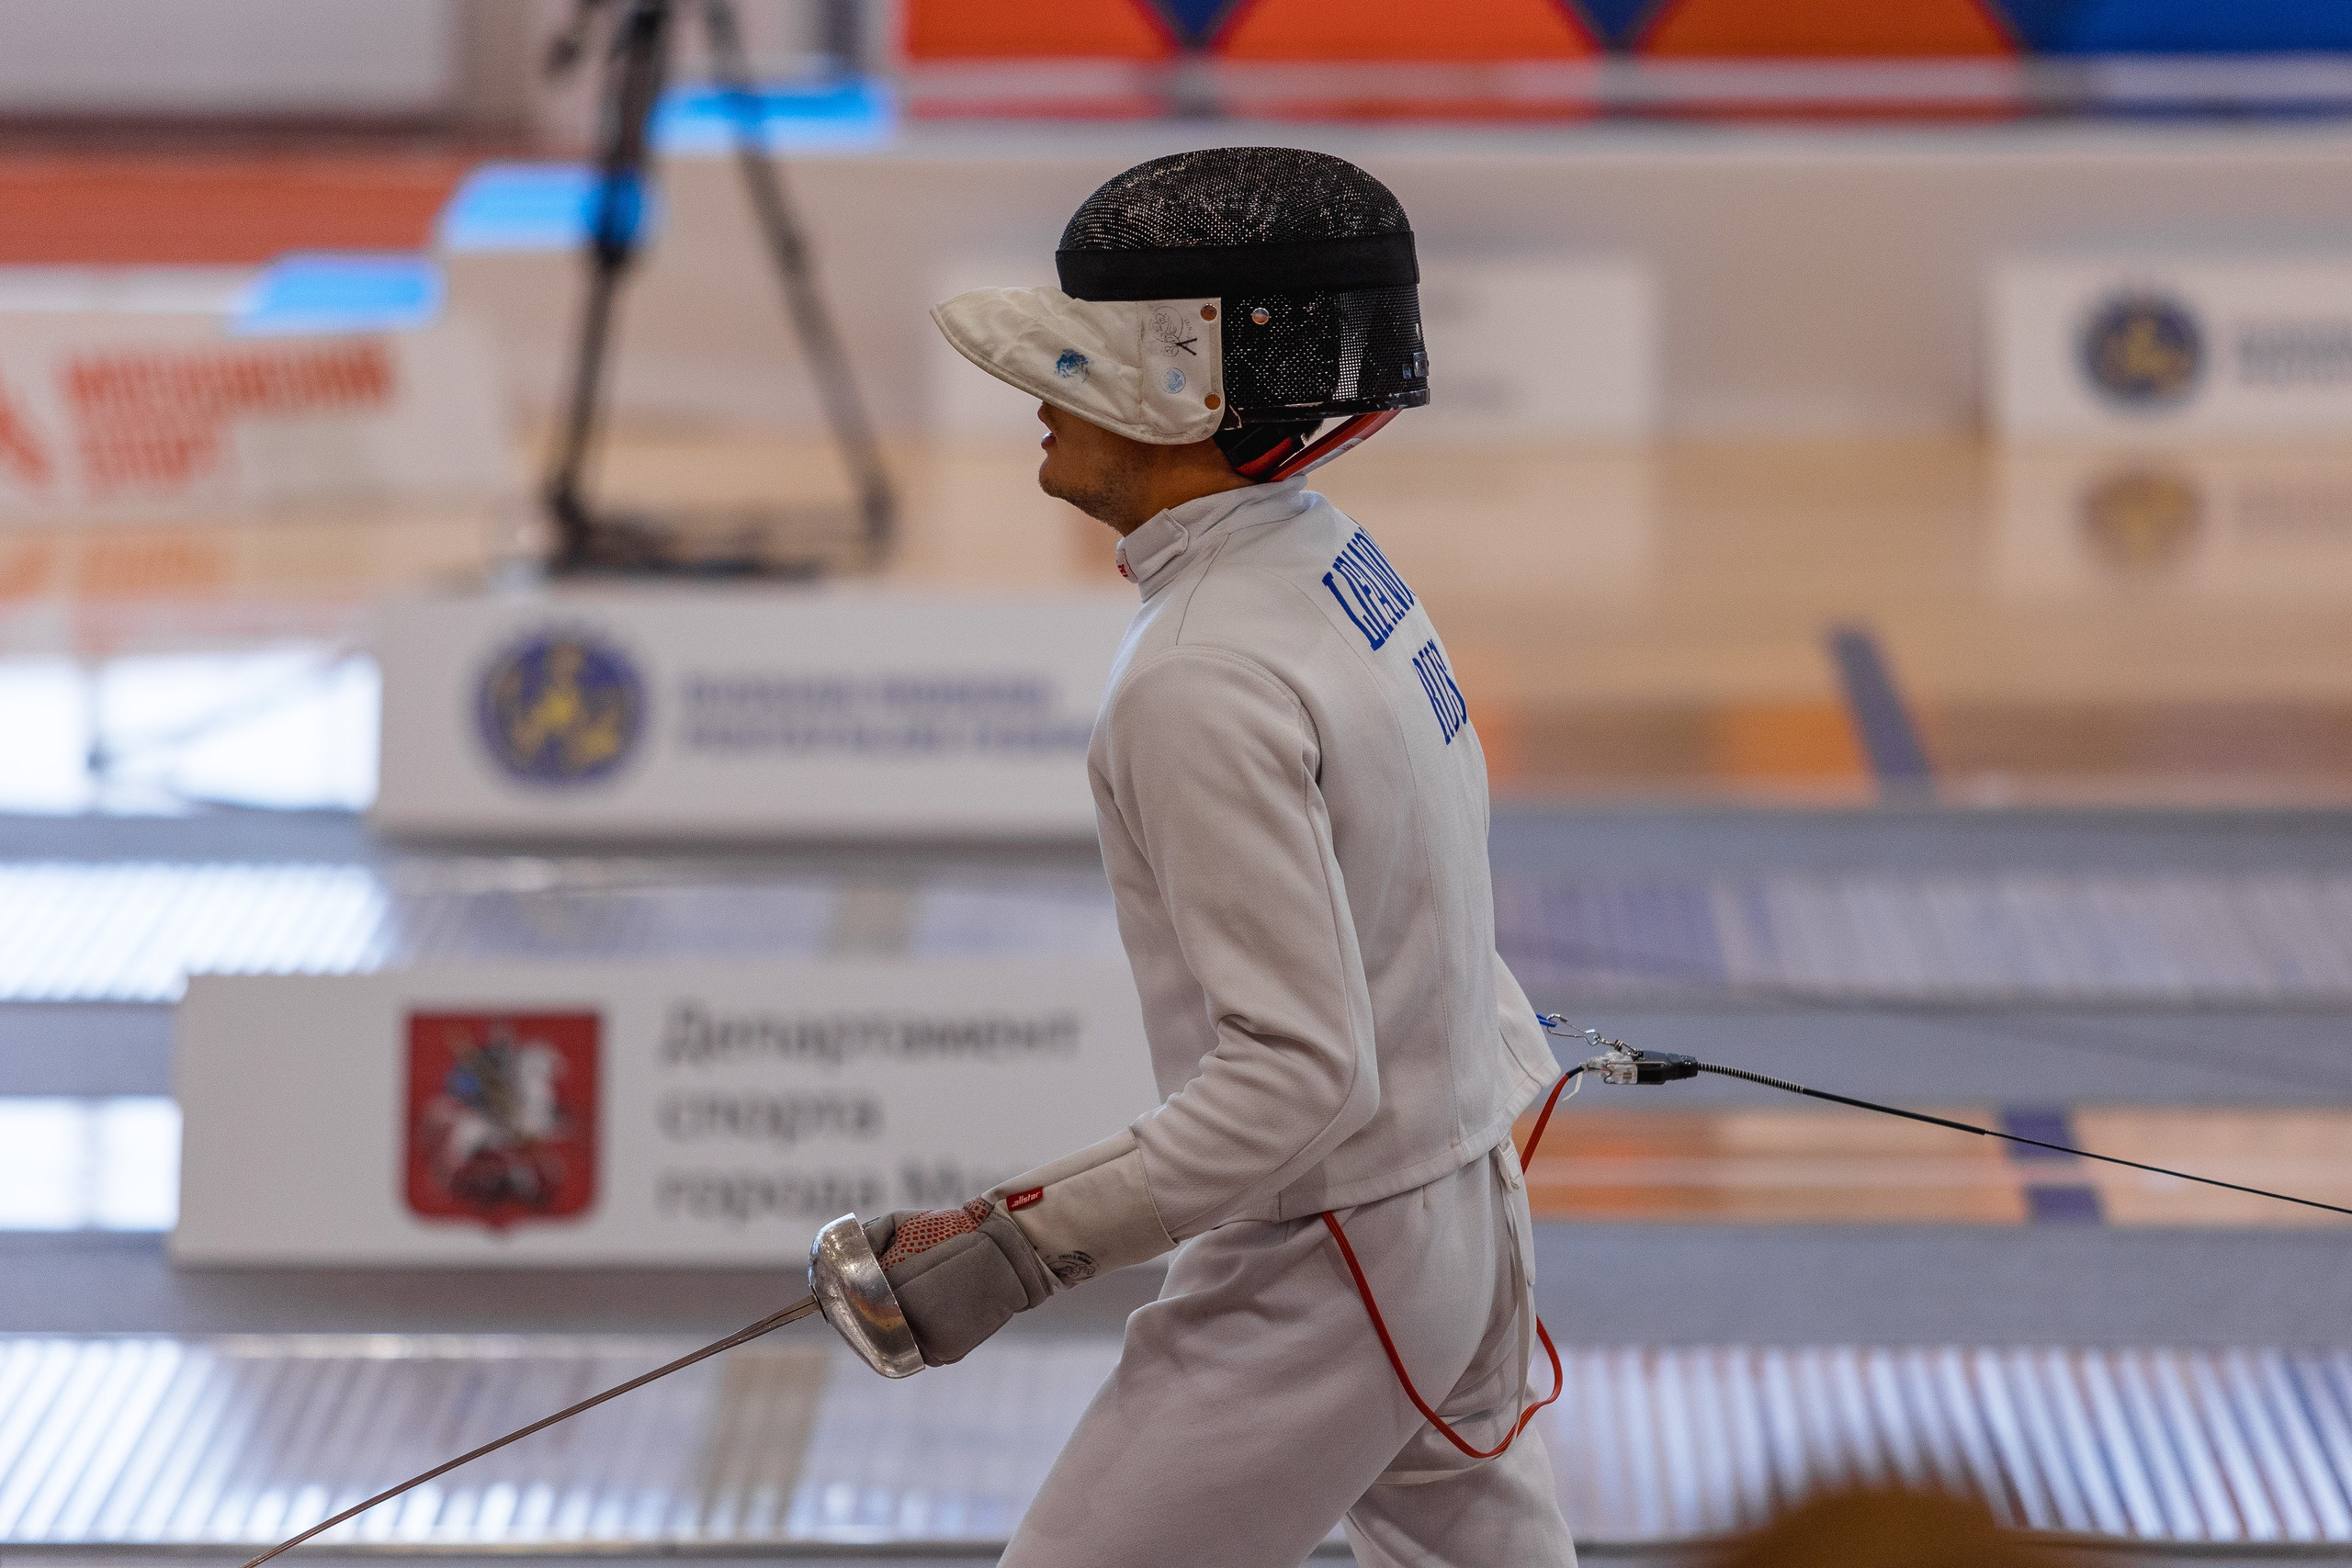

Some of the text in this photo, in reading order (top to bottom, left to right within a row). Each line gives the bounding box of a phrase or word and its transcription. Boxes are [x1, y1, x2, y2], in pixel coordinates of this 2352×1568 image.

[1321, 526, 1417, 651] LIFANO
[1412, 638, 1467, 746] RUS
[662, 1004, 1078, 1069] Департамент
[660, 1097, 882, 1146] спорта
